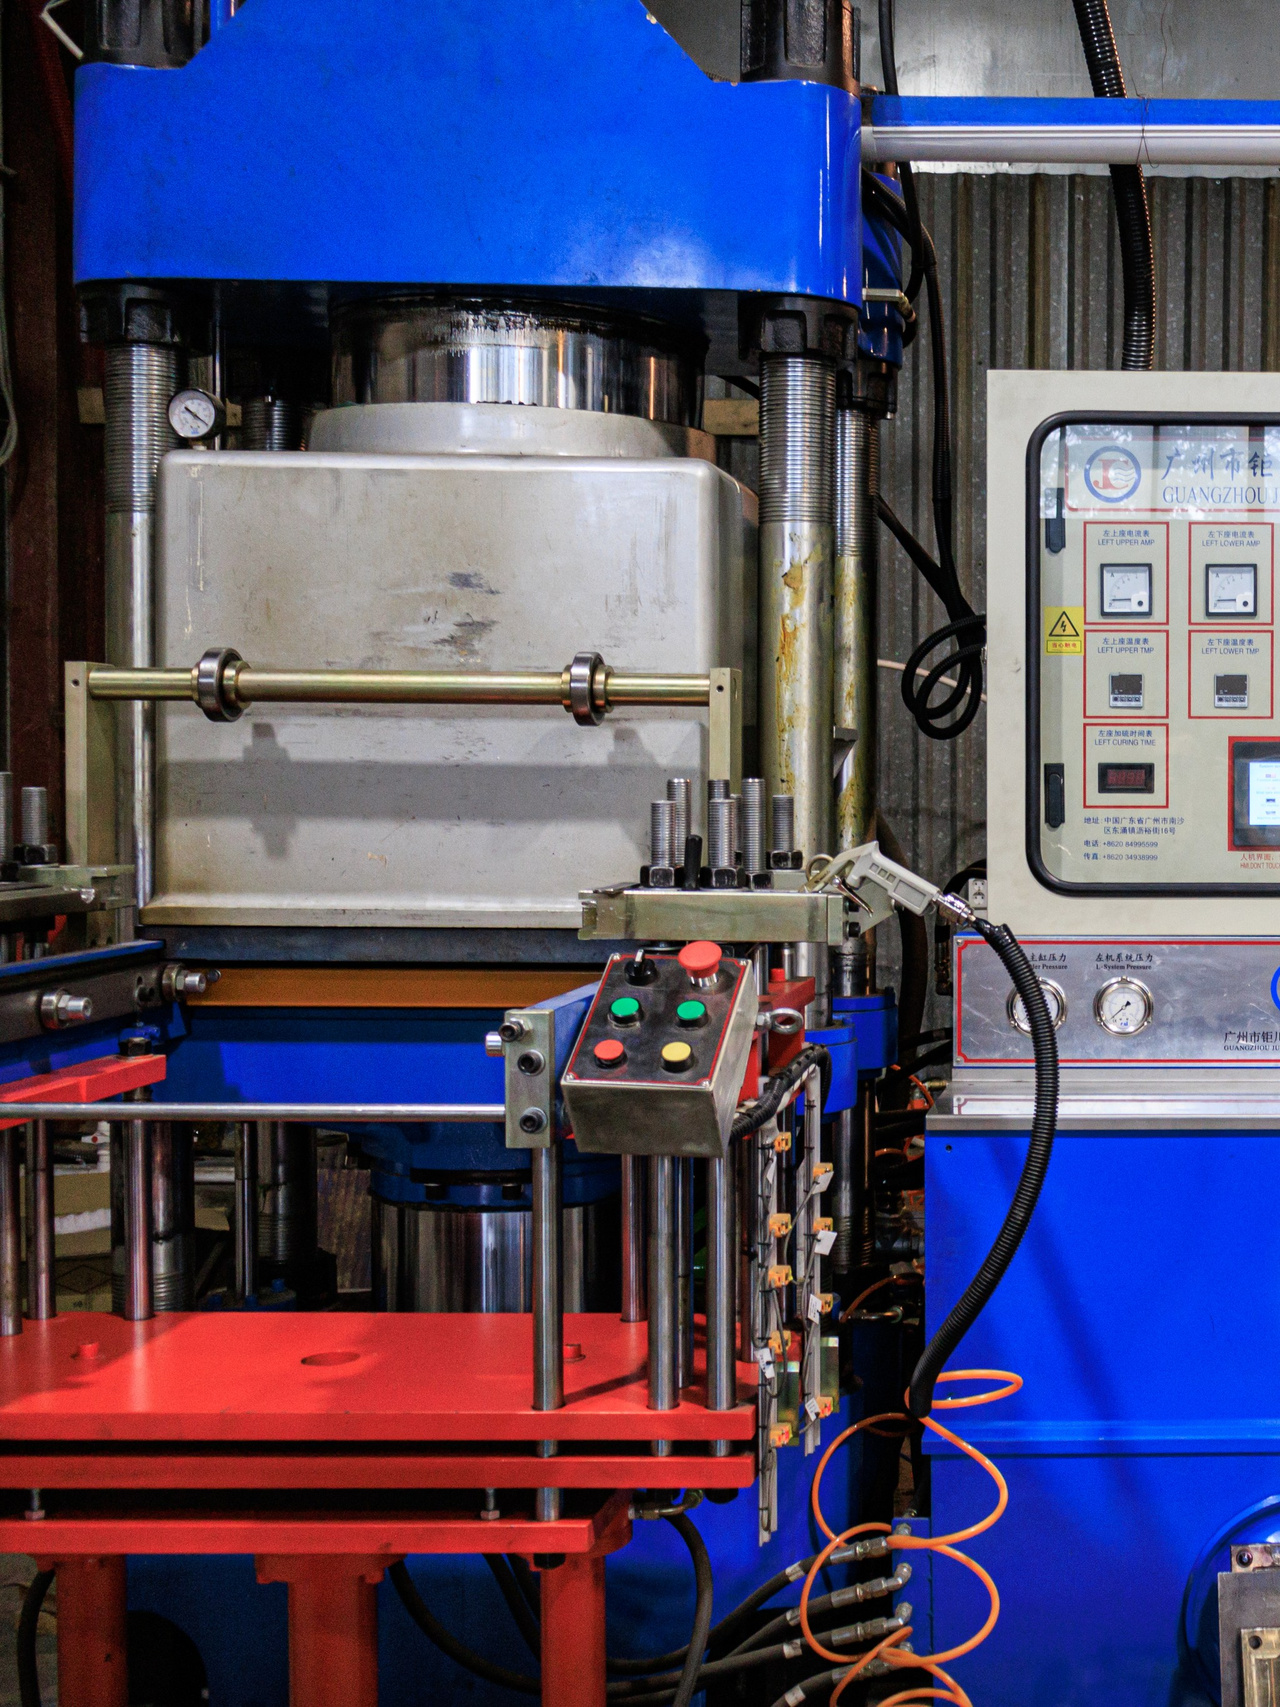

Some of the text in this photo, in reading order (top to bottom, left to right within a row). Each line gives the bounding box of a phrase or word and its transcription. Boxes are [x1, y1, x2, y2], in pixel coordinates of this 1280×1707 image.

[1162, 486, 1267, 504] GUANGZHOU
[1095, 952, 1153, 963] 左机系统压力
